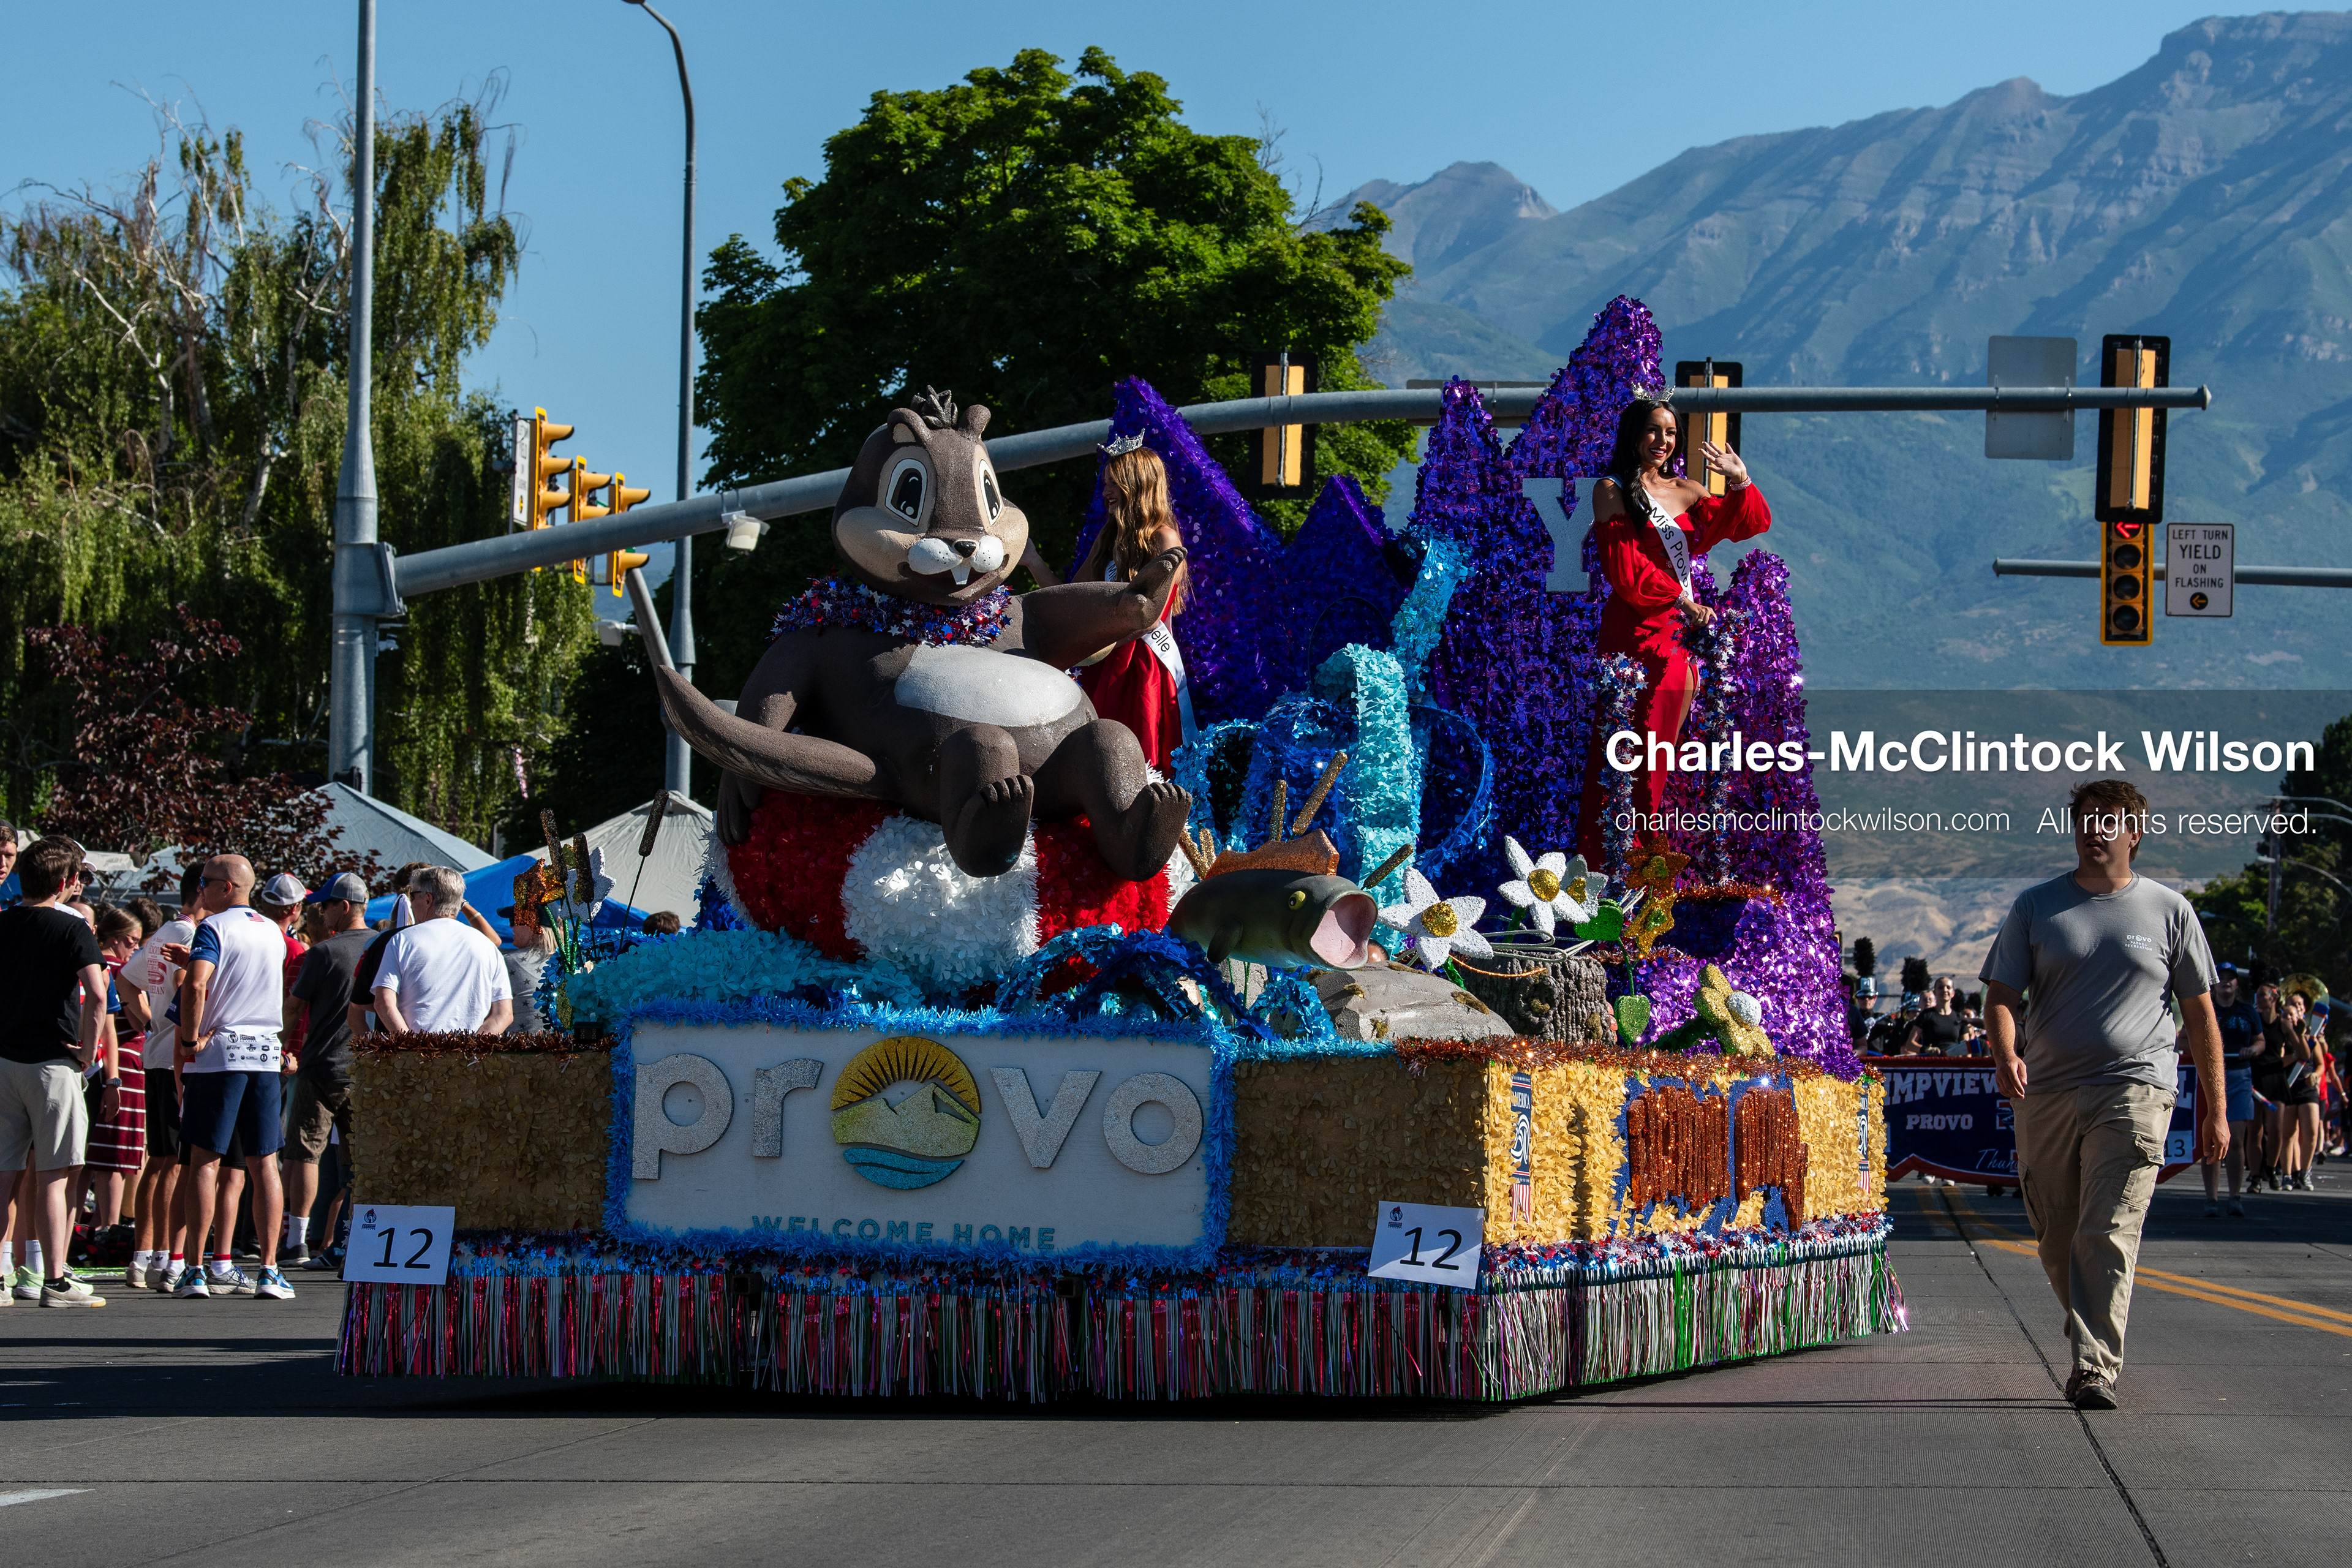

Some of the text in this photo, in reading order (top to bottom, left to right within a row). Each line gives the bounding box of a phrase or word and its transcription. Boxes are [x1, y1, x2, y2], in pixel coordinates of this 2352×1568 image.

[1522, 477, 1600, 592] Y
[1652, 507, 1675, 540] Miss
[2173, 529, 2228, 540] LEFT TURN
[1670, 540, 1689, 587] Provo
[2179, 545, 2221, 559] YIELD
[2193, 564, 2207, 574] ON
[2175, 577, 2224, 588] FLASHING
[1147, 629, 1170, 652] elle
[1906, 1114, 1973, 1131] PROVO
[373, 1227, 431, 1269] 12
[953, 1223, 1055, 1250] HOME
[1400, 1226, 1462, 1271] 12
